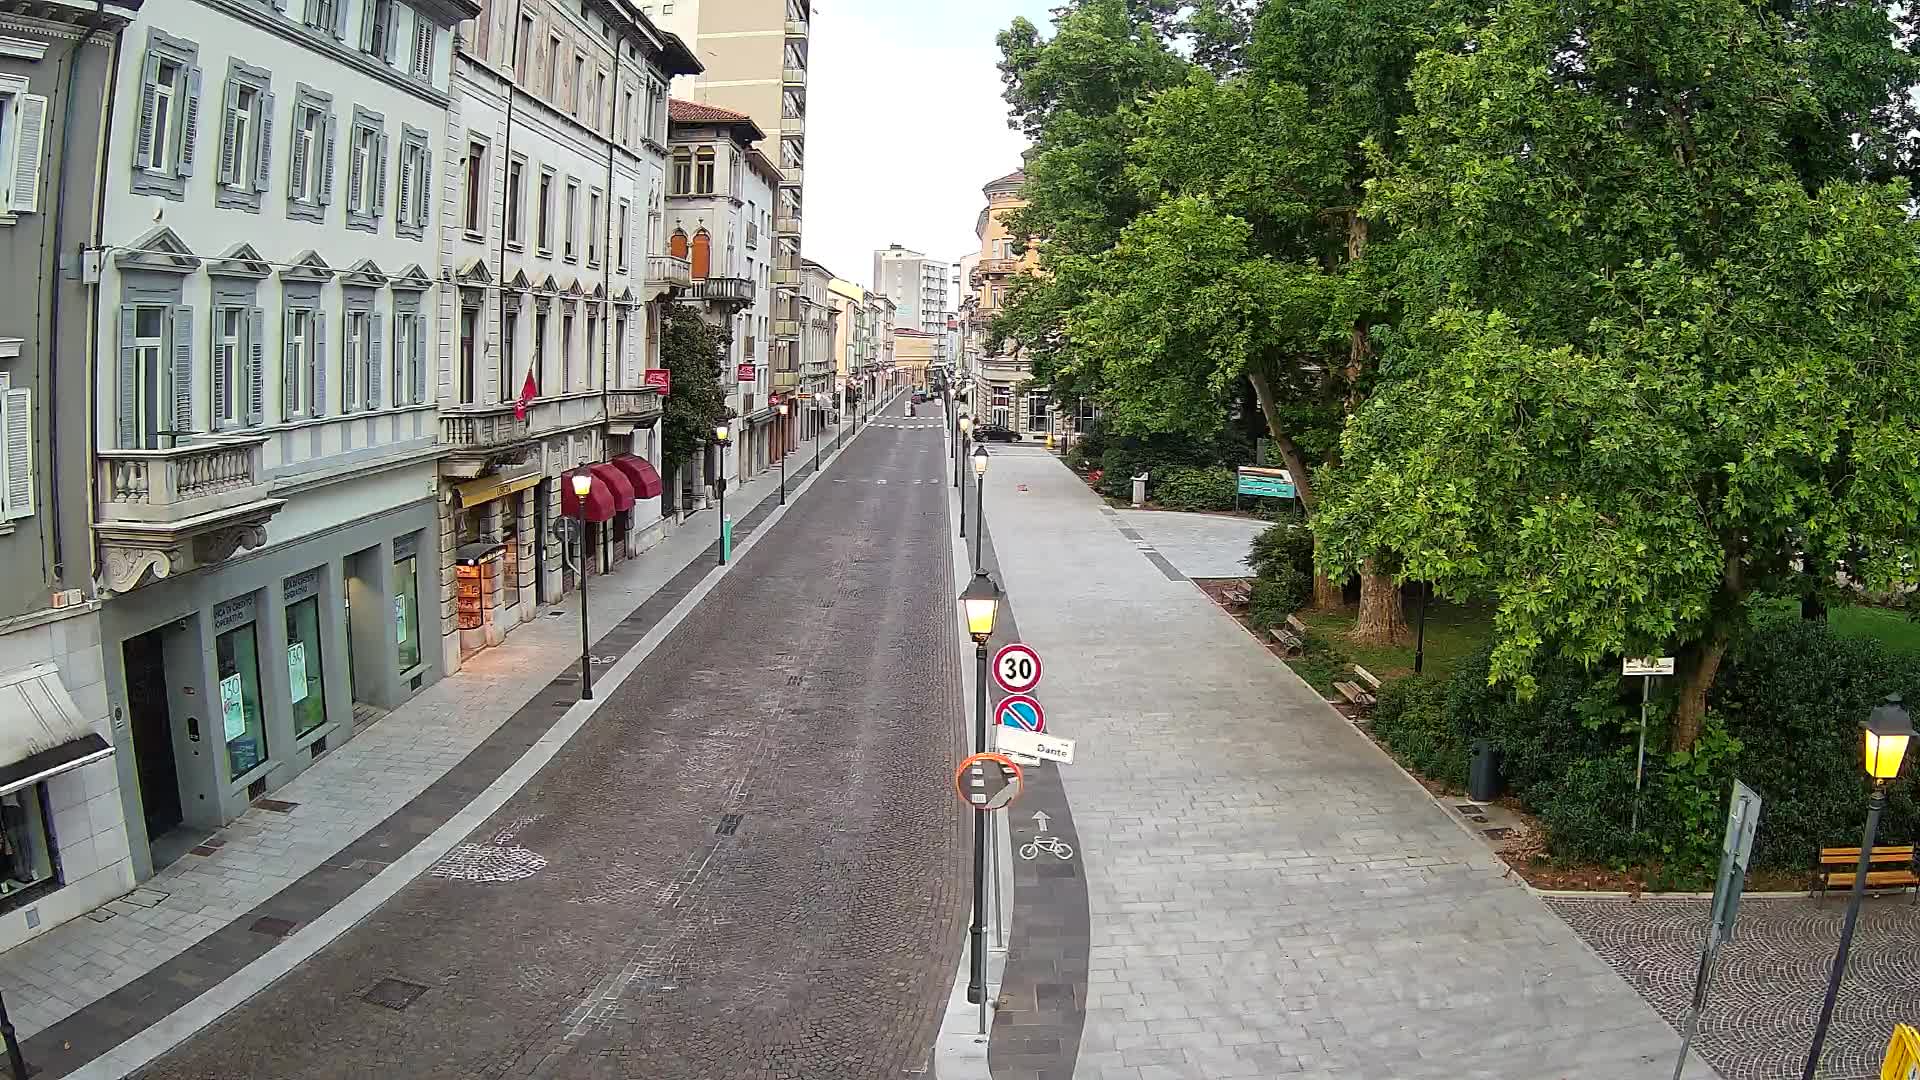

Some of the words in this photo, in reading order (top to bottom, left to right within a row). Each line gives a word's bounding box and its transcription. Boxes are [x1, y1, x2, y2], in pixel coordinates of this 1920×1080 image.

[1005, 658, 1032, 679] 30
[222, 677, 240, 700] 130
[1037, 744, 1067, 757] Dante
